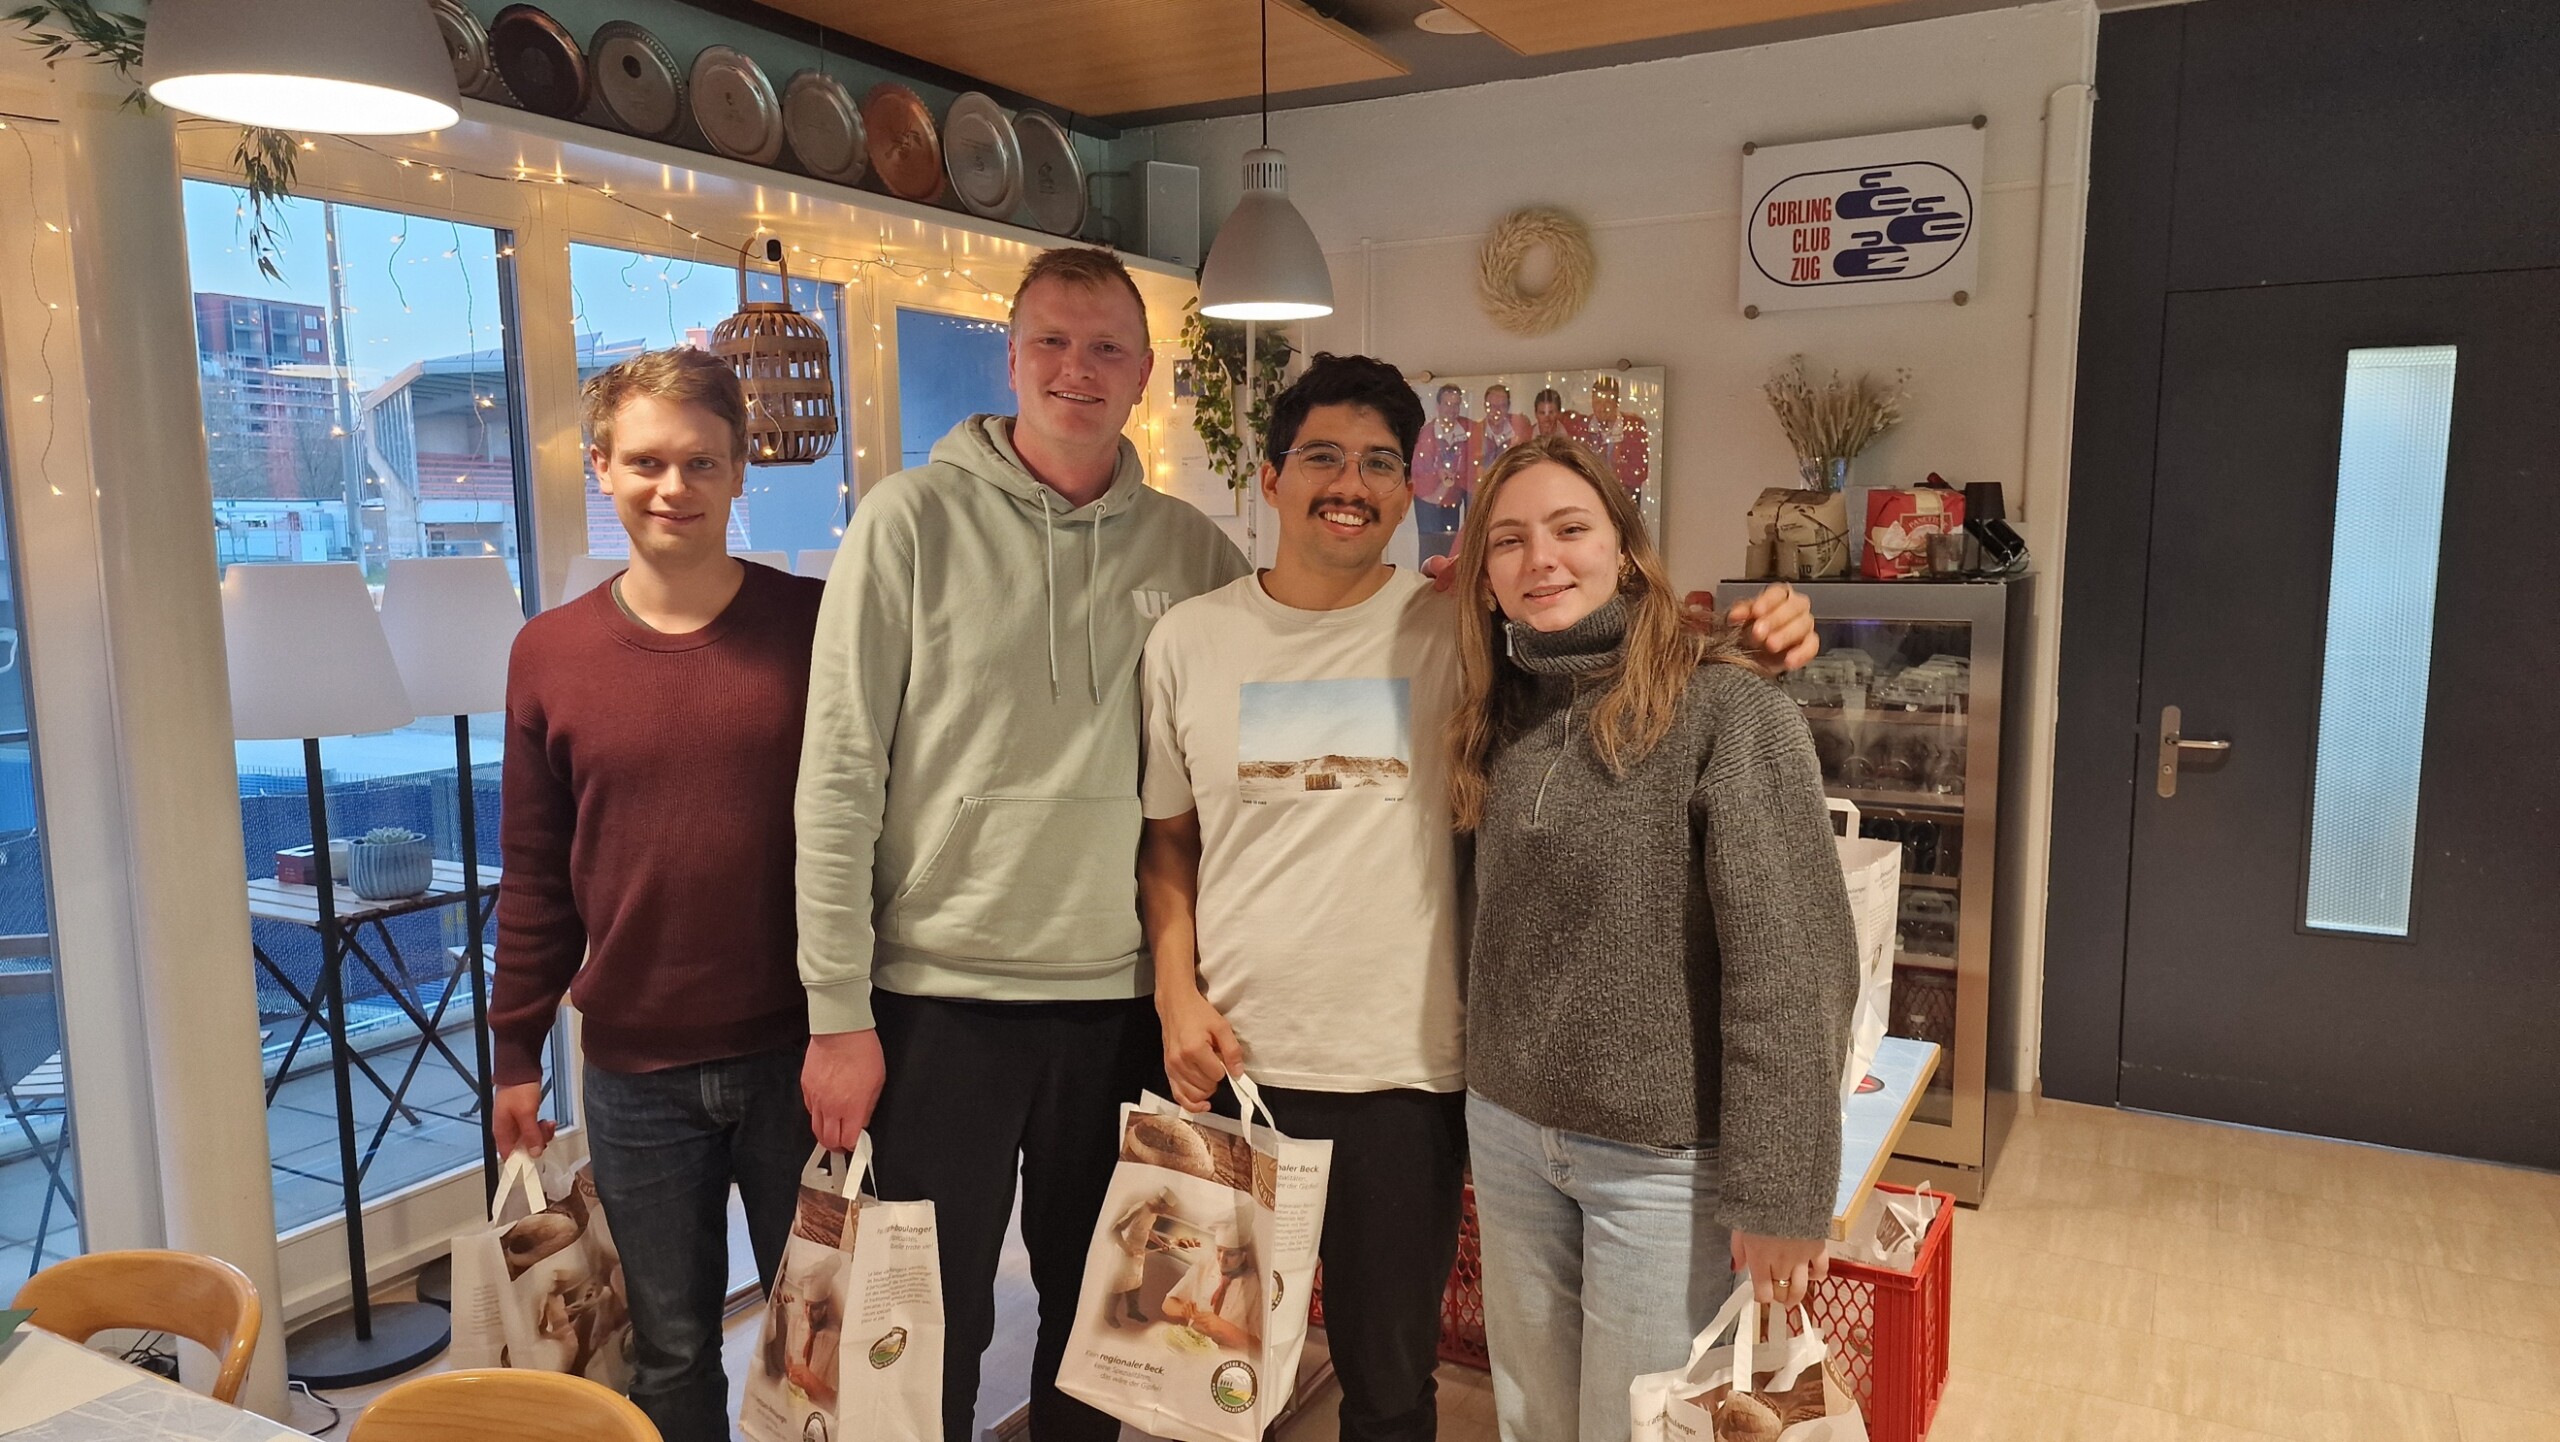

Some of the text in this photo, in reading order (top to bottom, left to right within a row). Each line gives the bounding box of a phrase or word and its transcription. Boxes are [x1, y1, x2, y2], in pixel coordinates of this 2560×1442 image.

[1767, 197, 1832, 227] CURLING
[1792, 226, 1831, 254] CLUB
[1790, 255, 1821, 281] ZUG
[1099, 1353, 1144, 1369] regionaler
[1129, 1379, 1140, 1388] der
